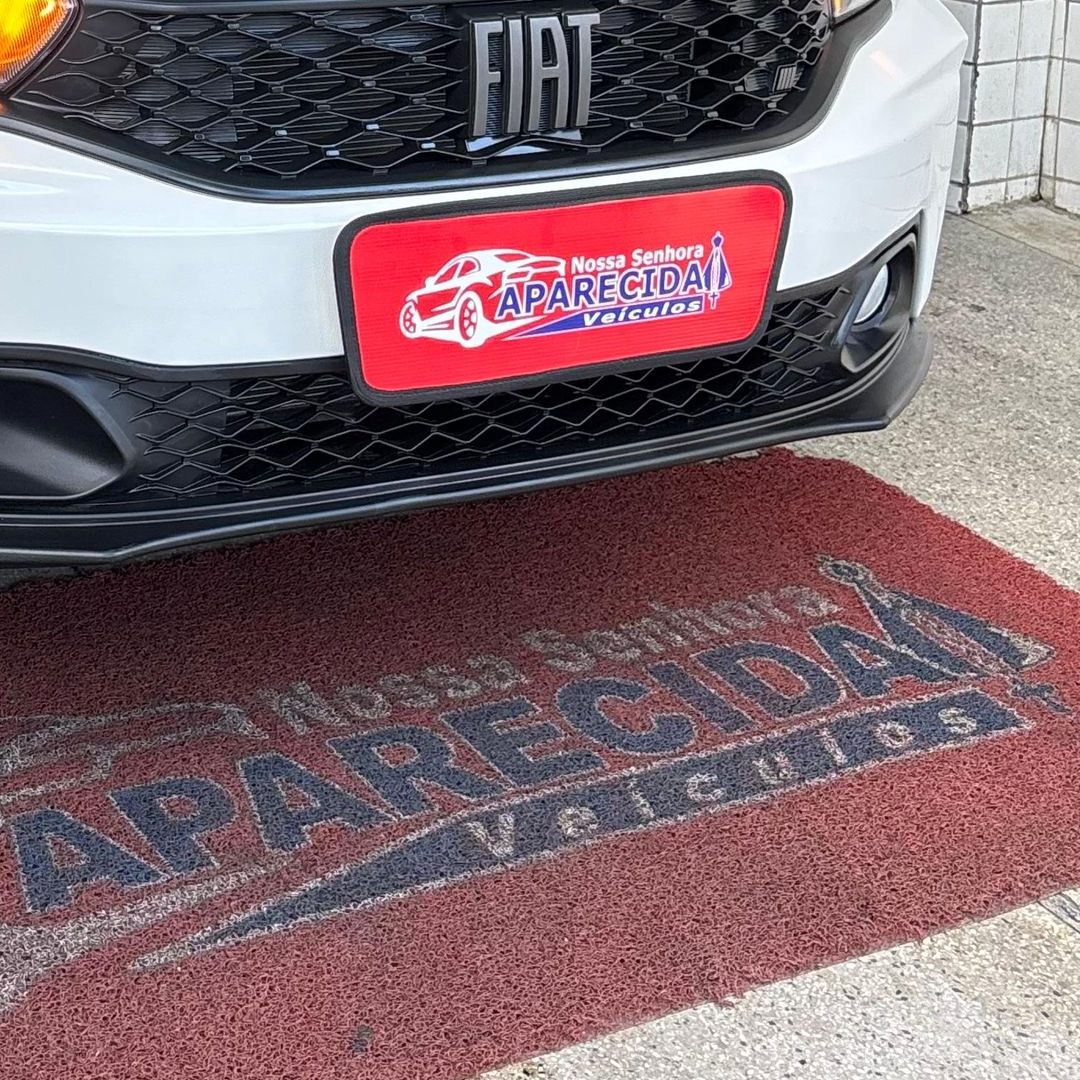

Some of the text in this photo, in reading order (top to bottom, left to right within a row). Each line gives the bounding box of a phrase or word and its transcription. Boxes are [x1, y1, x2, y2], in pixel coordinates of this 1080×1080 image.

[471, 12, 601, 137] FIAT
[495, 262, 705, 319] APARECIDA
[571, 244, 704, 275] Nossa Senhora
[582, 298, 701, 327] Veículos
[257, 585, 843, 736] Nossa Senhora
[10, 622, 958, 913] APARECIDA
